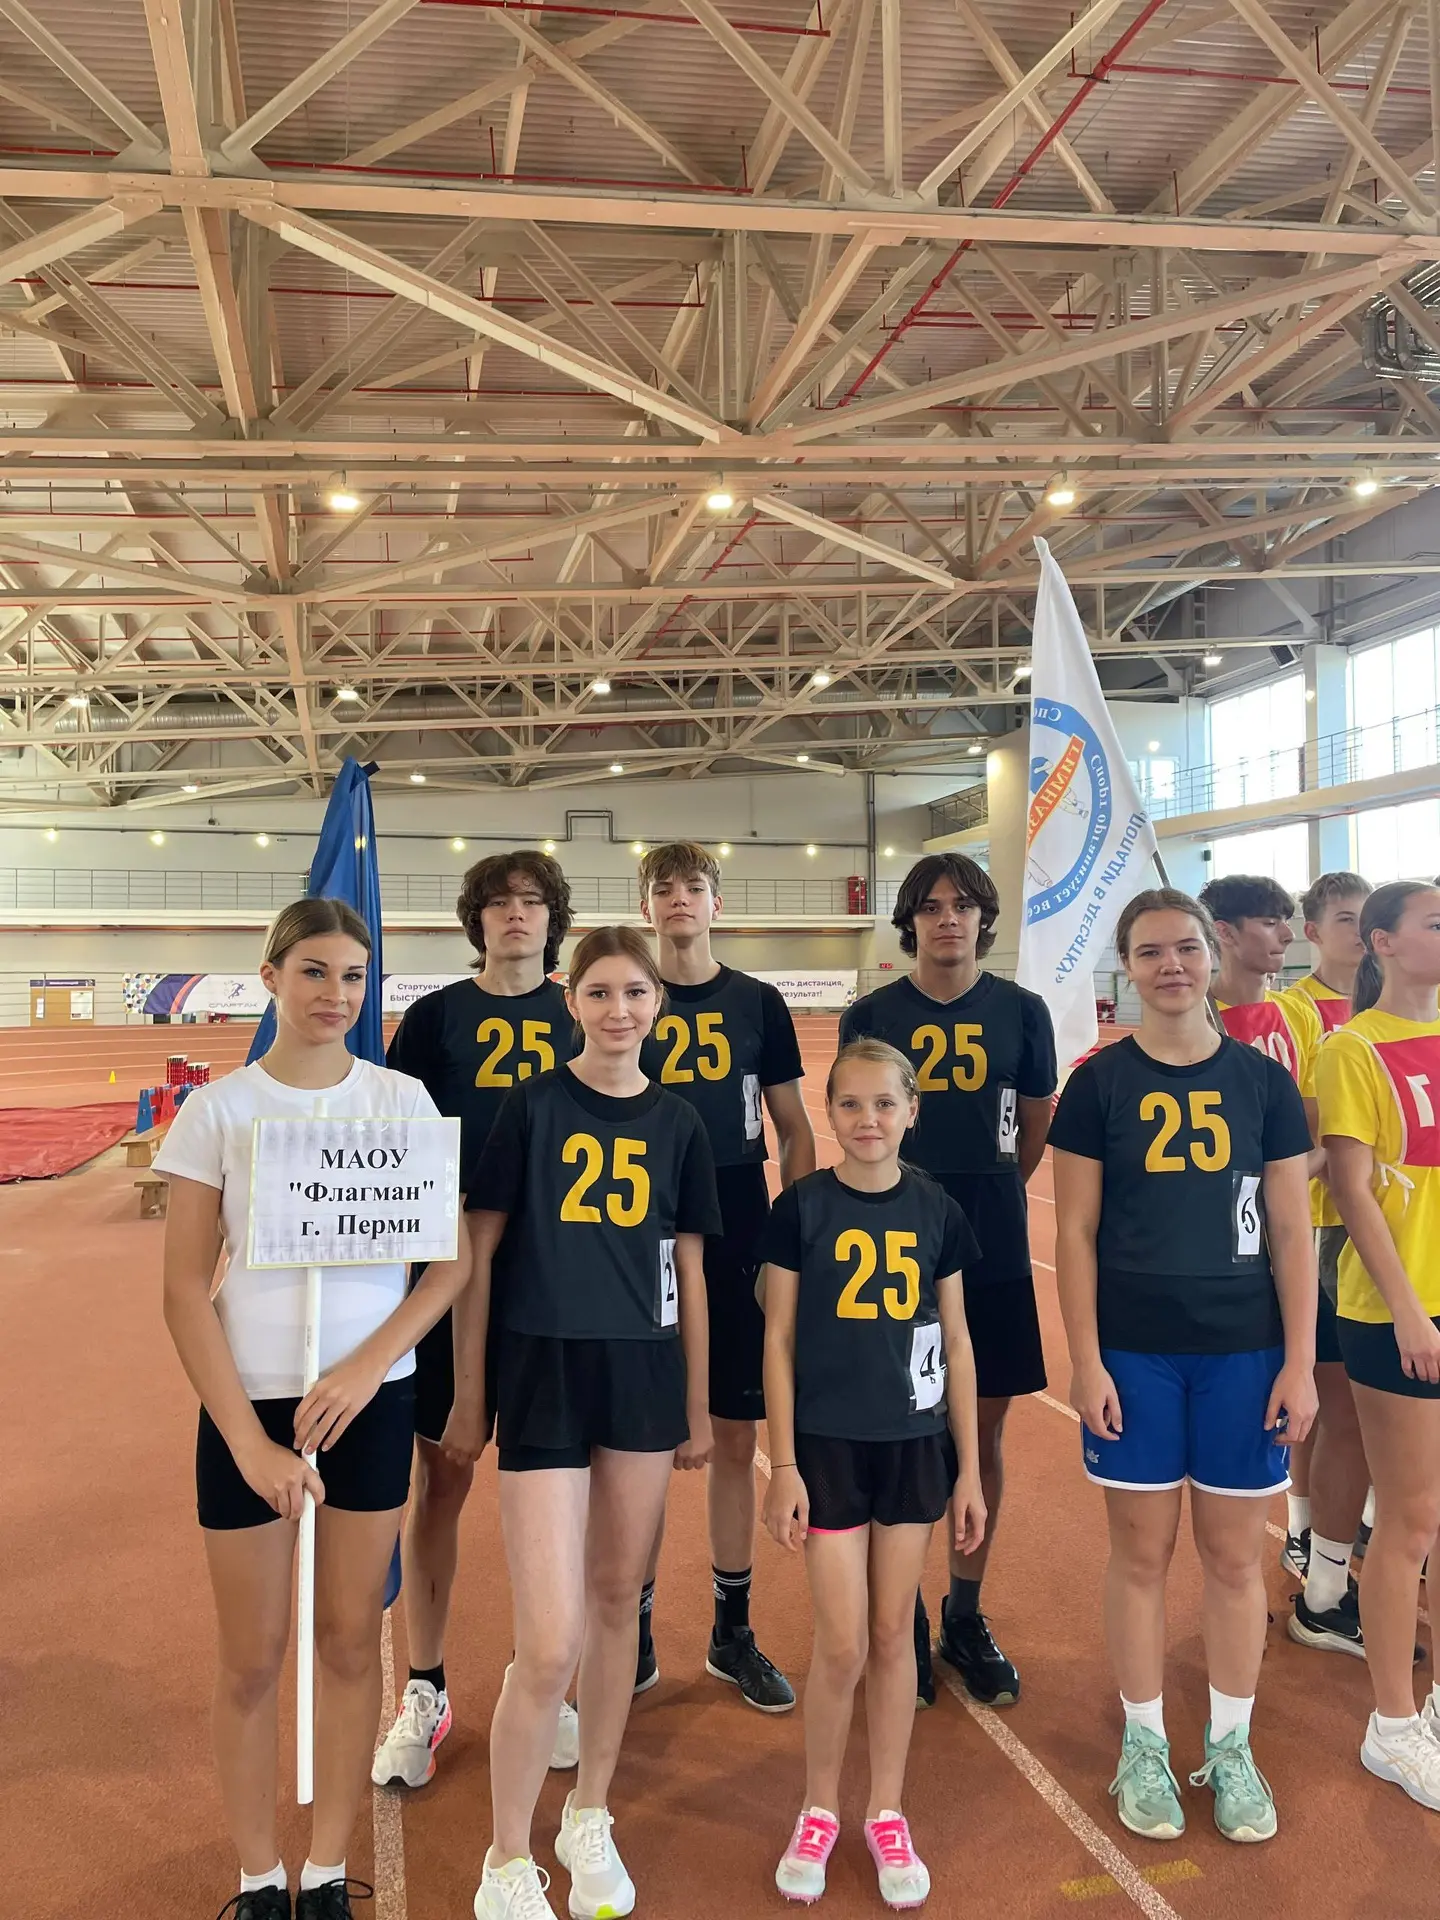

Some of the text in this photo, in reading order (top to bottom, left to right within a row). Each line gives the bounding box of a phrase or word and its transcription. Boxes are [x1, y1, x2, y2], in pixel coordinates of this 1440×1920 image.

[390, 994, 426, 1002] БЫСТР
[397, 983, 440, 991] Стартуем
[796, 980, 844, 988] дистанция,
[475, 1017, 555, 1088] 25
[655, 1012, 732, 1085] 25
[911, 1023, 988, 1092] 25
[751, 1091, 761, 1122] 1
[1139, 1090, 1232, 1173] 25
[319, 1148, 409, 1170] МАОУ
[289, 1180, 435, 1203] "Флагман"
[560, 1132, 650, 1228] 25
[301, 1214, 421, 1240] г. Перми
[1241, 1196, 1256, 1235] 6
[834, 1228, 921, 1321] 25
[919, 1344, 937, 1378] 4
